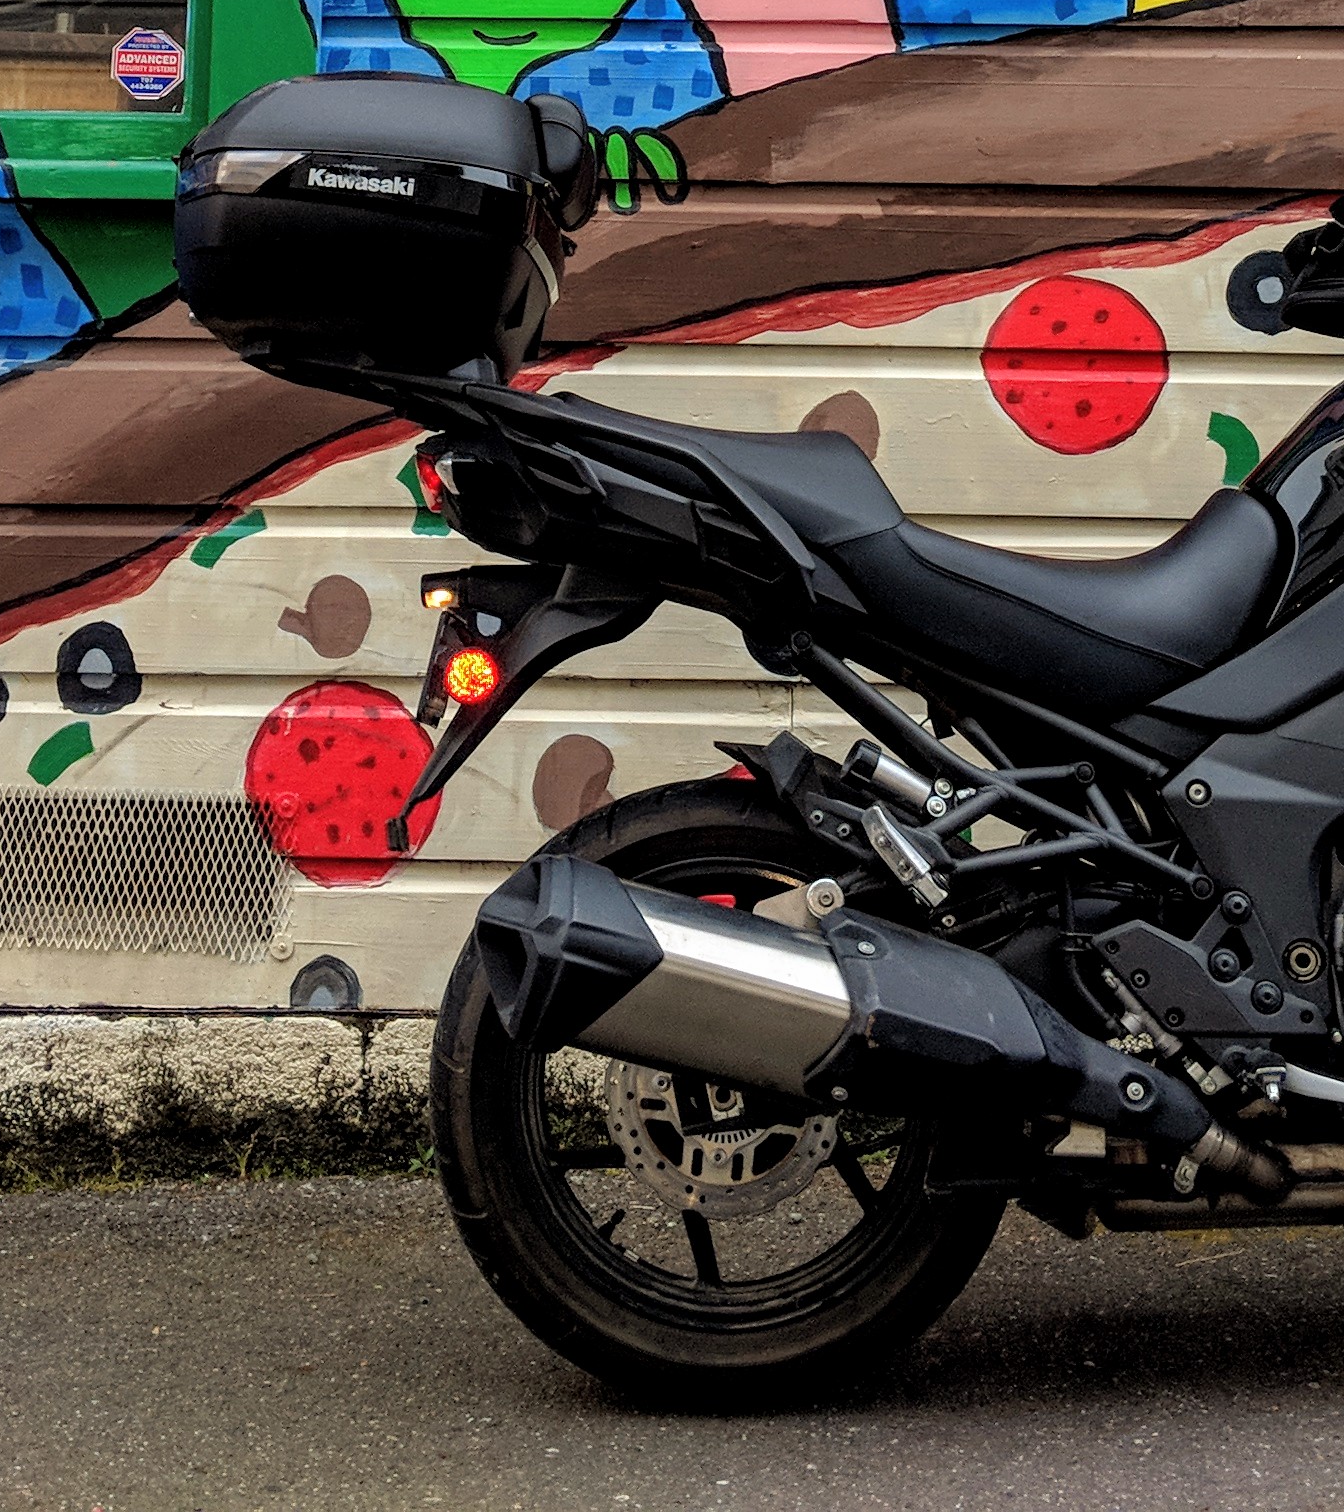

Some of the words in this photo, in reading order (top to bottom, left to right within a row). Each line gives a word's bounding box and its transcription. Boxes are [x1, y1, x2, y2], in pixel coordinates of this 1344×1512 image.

[119, 53, 177, 65] ADVANCED
[118, 64, 148, 72] SECURITY
[148, 65, 177, 73] SYSTEMS
[307, 167, 416, 197] Kawasaki
